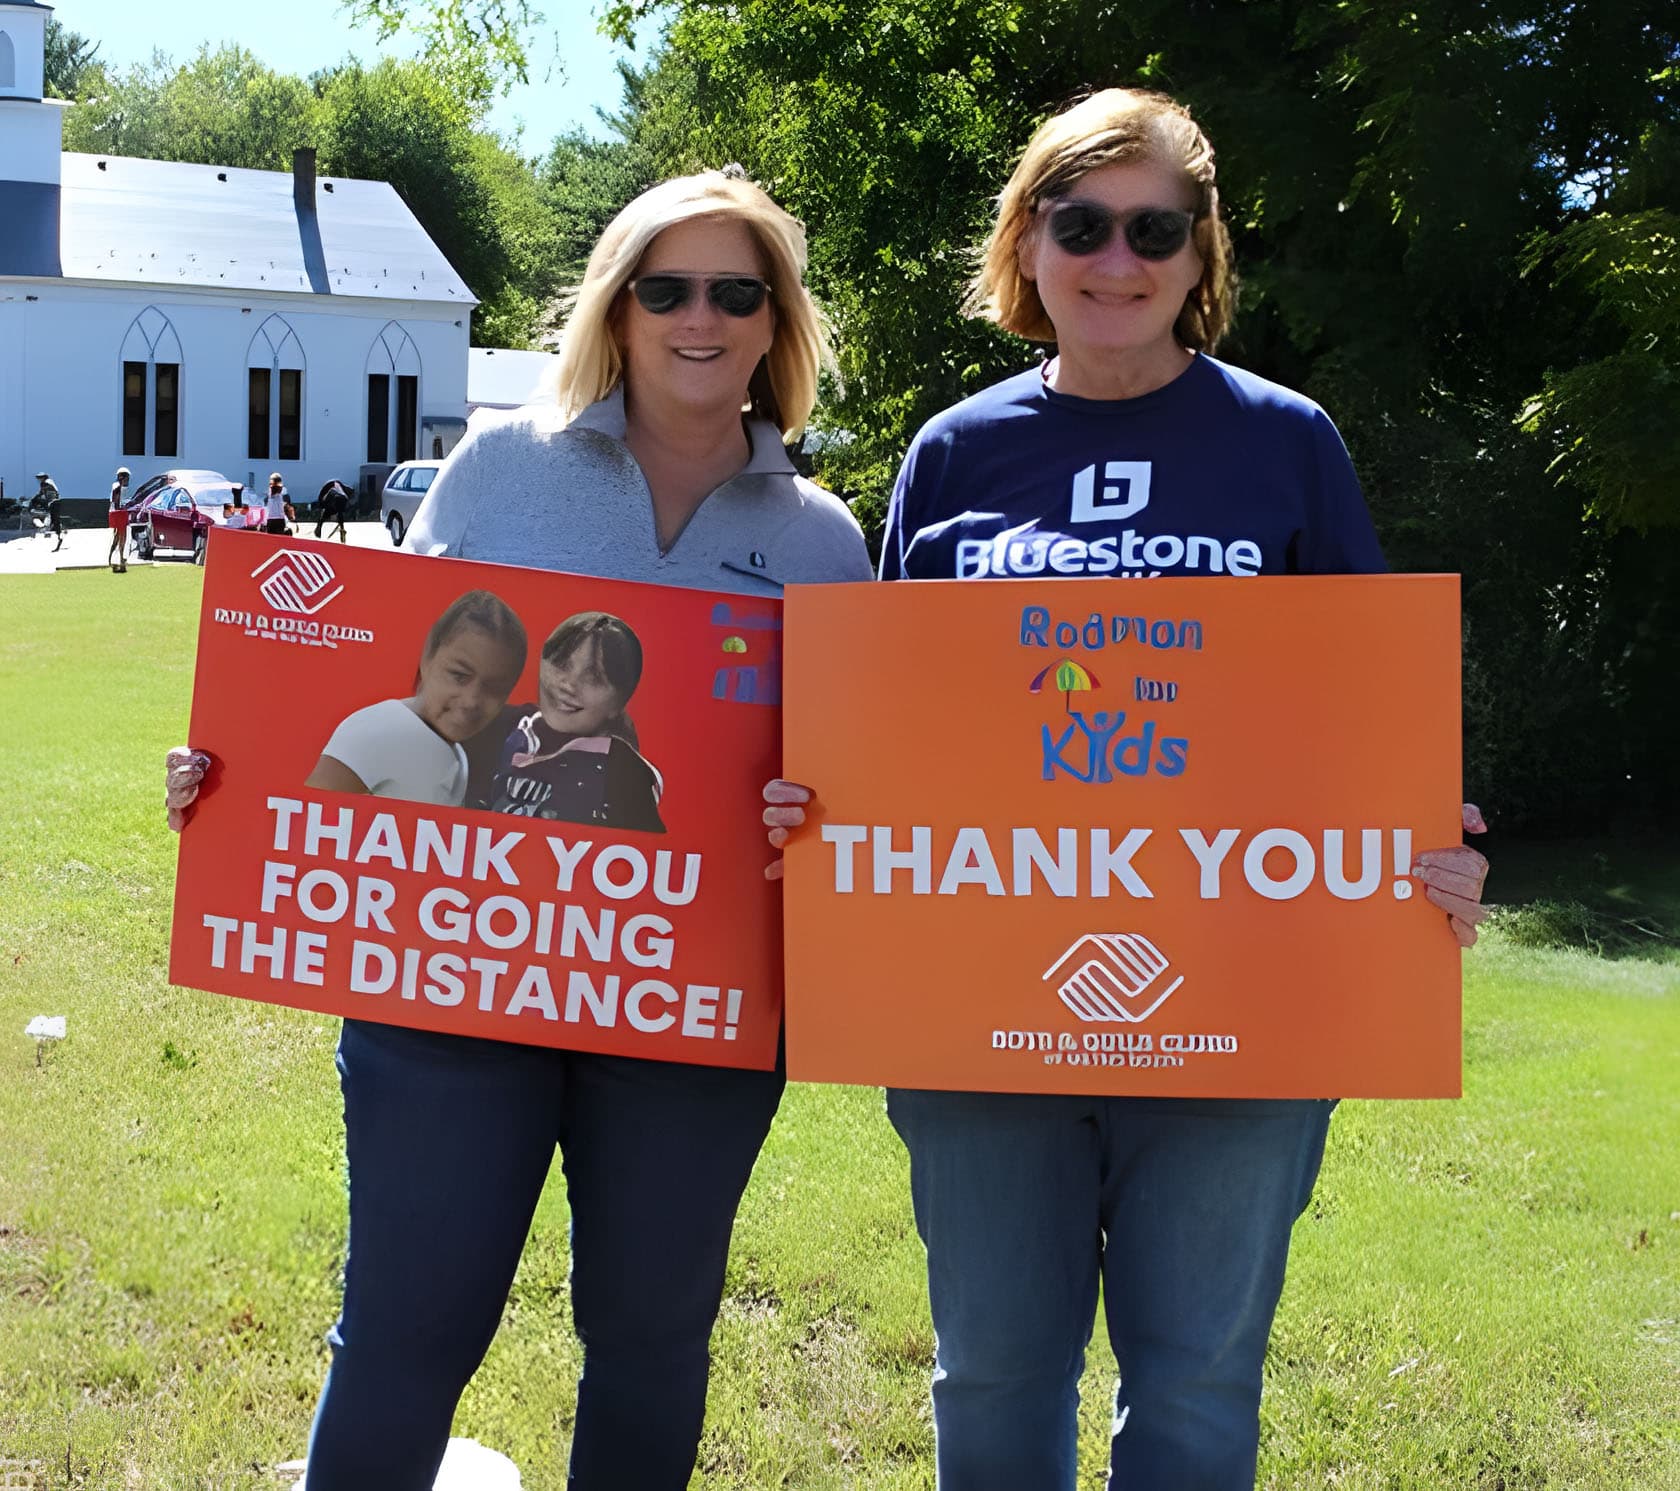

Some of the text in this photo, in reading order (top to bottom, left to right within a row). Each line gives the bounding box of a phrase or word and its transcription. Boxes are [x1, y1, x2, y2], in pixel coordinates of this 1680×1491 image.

[955, 529, 1263, 579] Bluestone
[267, 796, 702, 906] THANK YOU
[821, 824, 1414, 900] THANK YOU!
[260, 860, 675, 970] FOR GOING
[203, 914, 743, 1041] THE DISTANCE!
